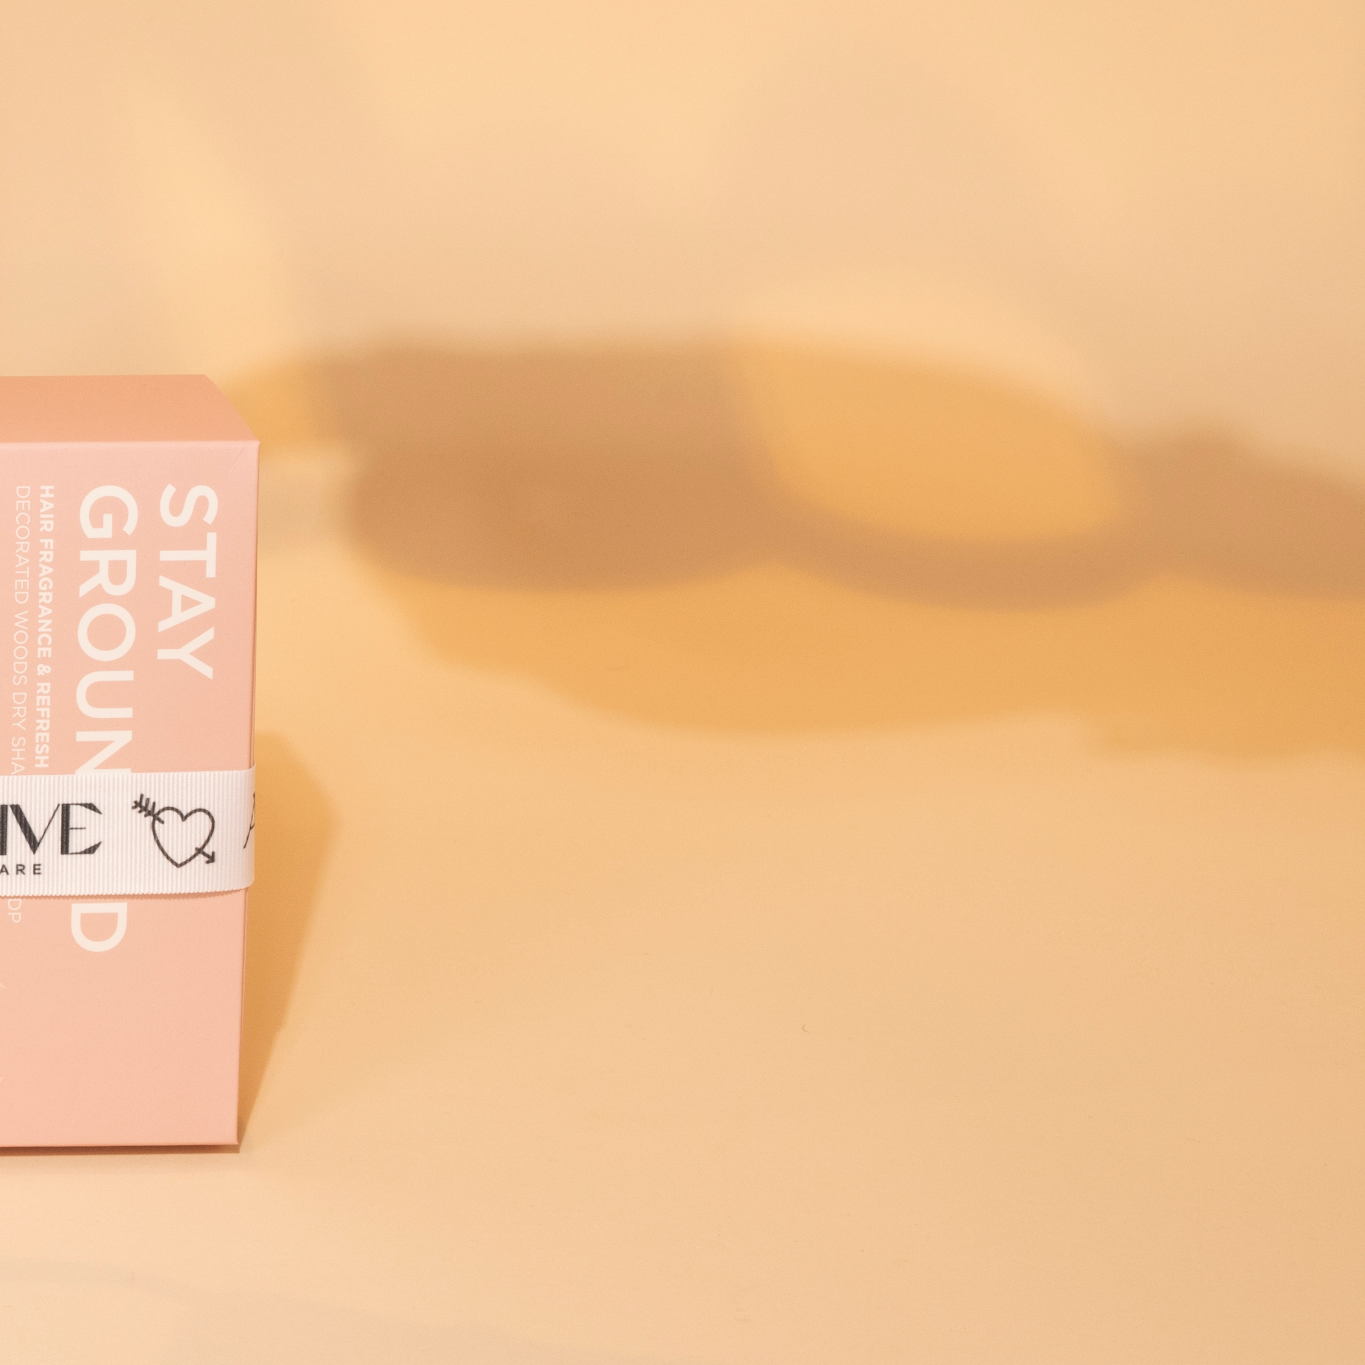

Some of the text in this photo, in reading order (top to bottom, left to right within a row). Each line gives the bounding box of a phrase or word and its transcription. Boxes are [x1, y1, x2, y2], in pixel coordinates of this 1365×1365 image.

[14, 485, 31, 605] DECORATED
[157, 483, 219, 680] STAY
[12, 610, 29, 686] WOODS
[34, 485, 55, 768] HAIR FRAGRANCE & REFRESH
[11, 691, 27, 733] DRY
[71, 484, 139, 952] GROUND
